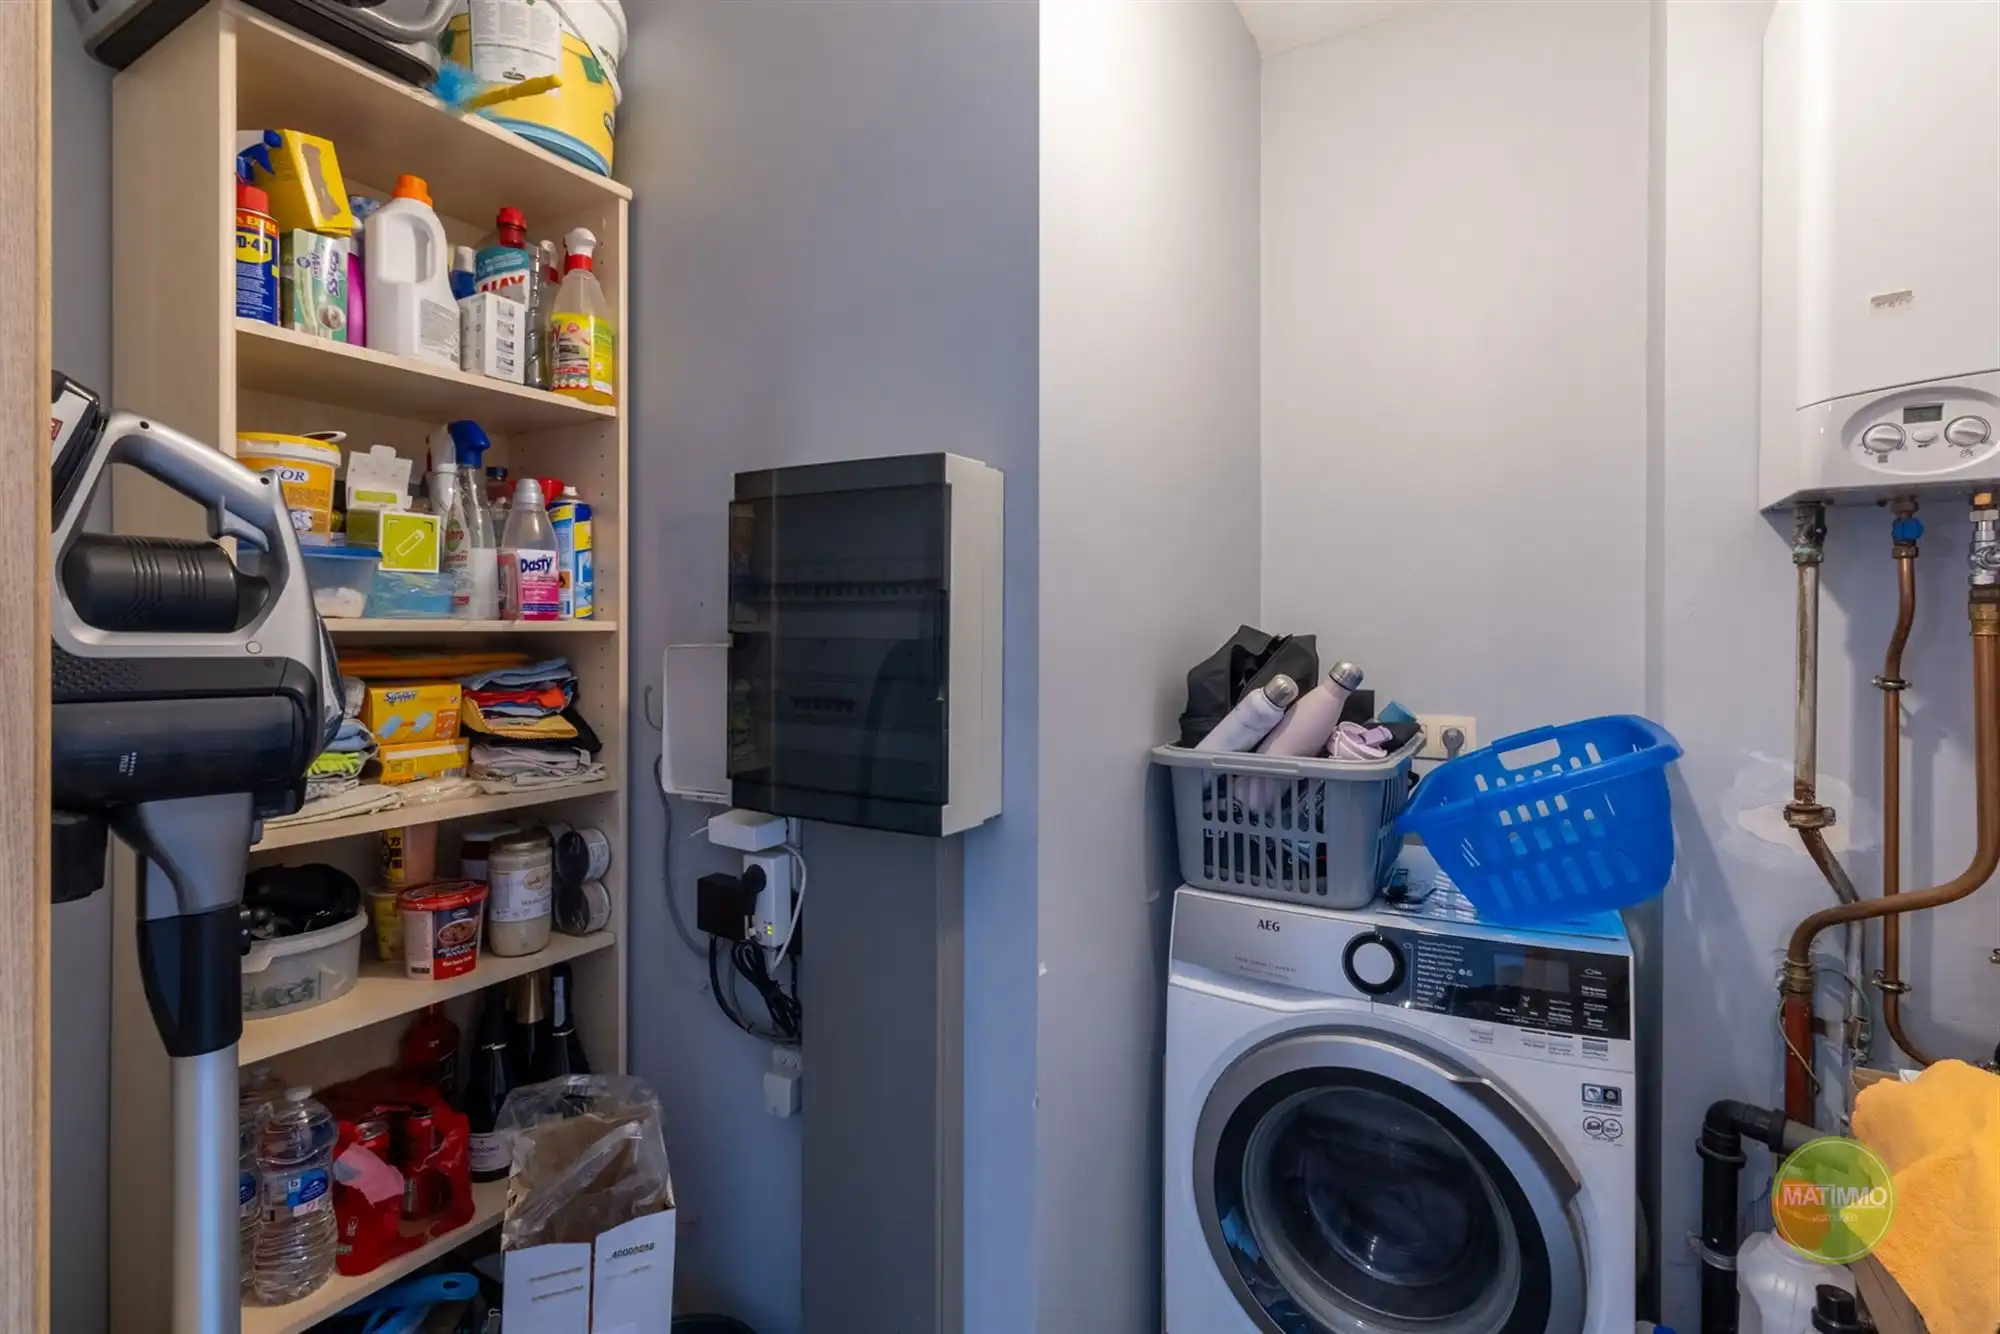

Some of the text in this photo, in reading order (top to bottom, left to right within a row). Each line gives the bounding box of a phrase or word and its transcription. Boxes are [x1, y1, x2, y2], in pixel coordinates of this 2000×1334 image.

[236, 234, 268, 254] D-40
[280, 469, 305, 482] OR
[520, 556, 553, 573] Dasty
[1257, 919, 1280, 932] AEG
